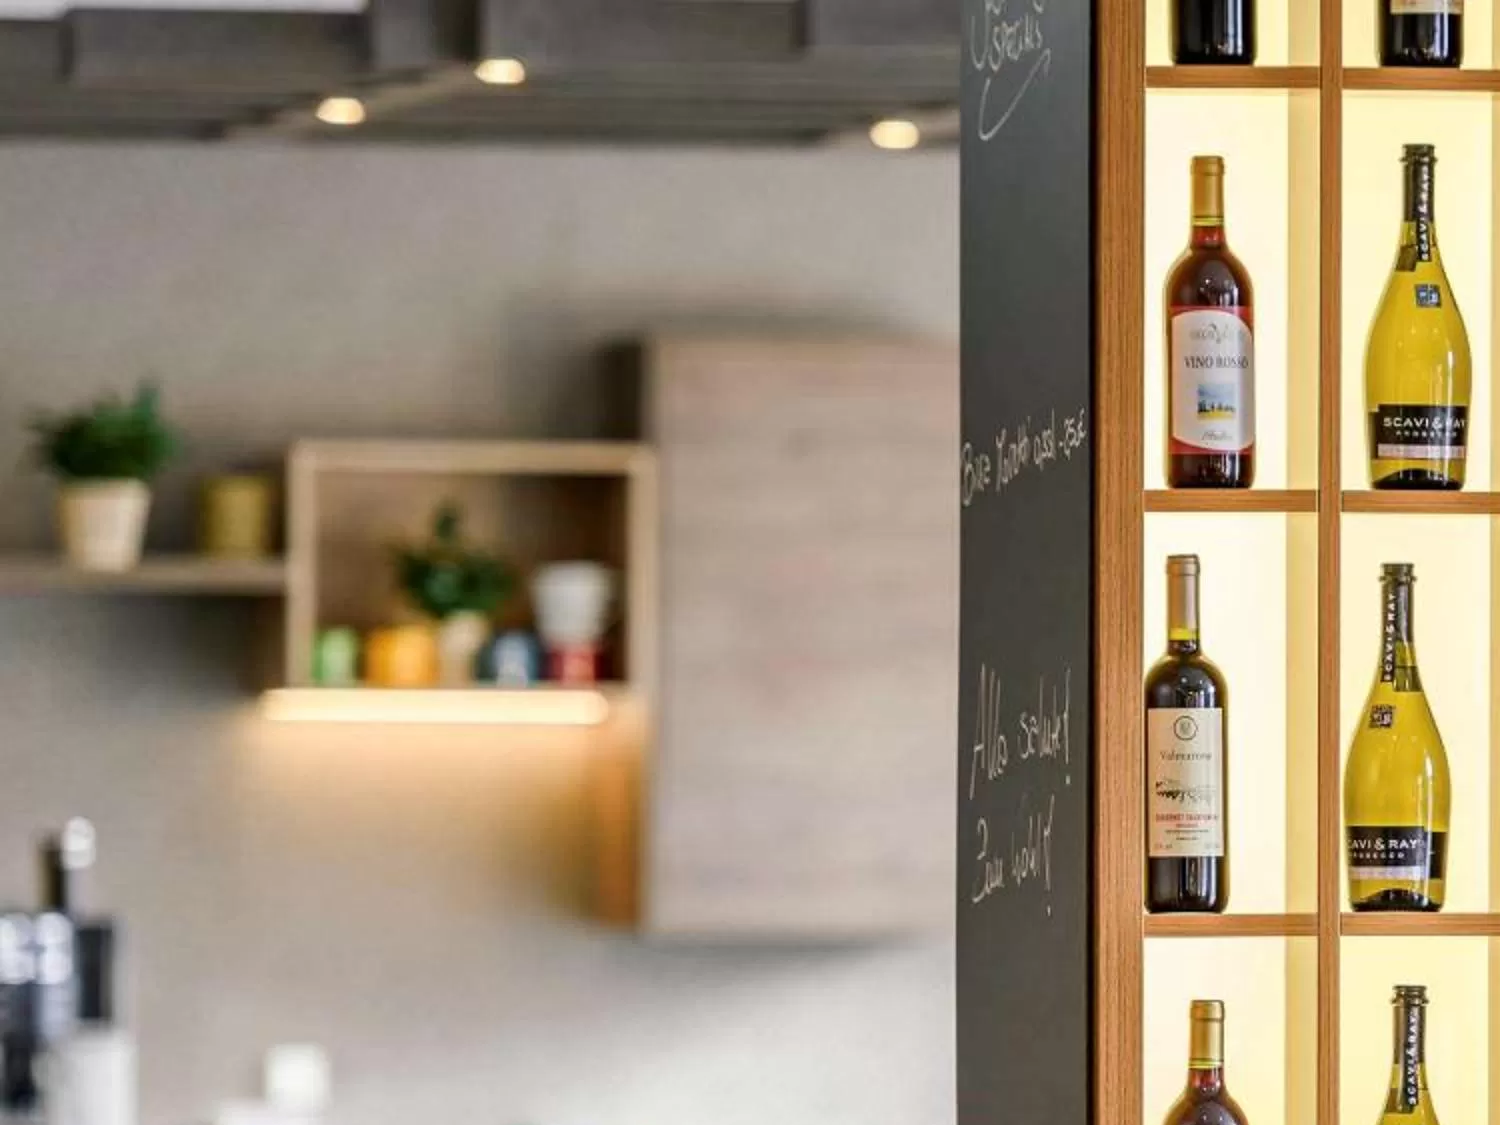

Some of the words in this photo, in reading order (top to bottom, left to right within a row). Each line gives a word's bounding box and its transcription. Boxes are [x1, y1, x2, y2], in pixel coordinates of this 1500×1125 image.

[1184, 355, 1214, 369] VINO
[1383, 417, 1429, 428] SCAVI
[1432, 416, 1443, 429] &
[1374, 837, 1385, 851] &
[1389, 839, 1417, 849] RAY
